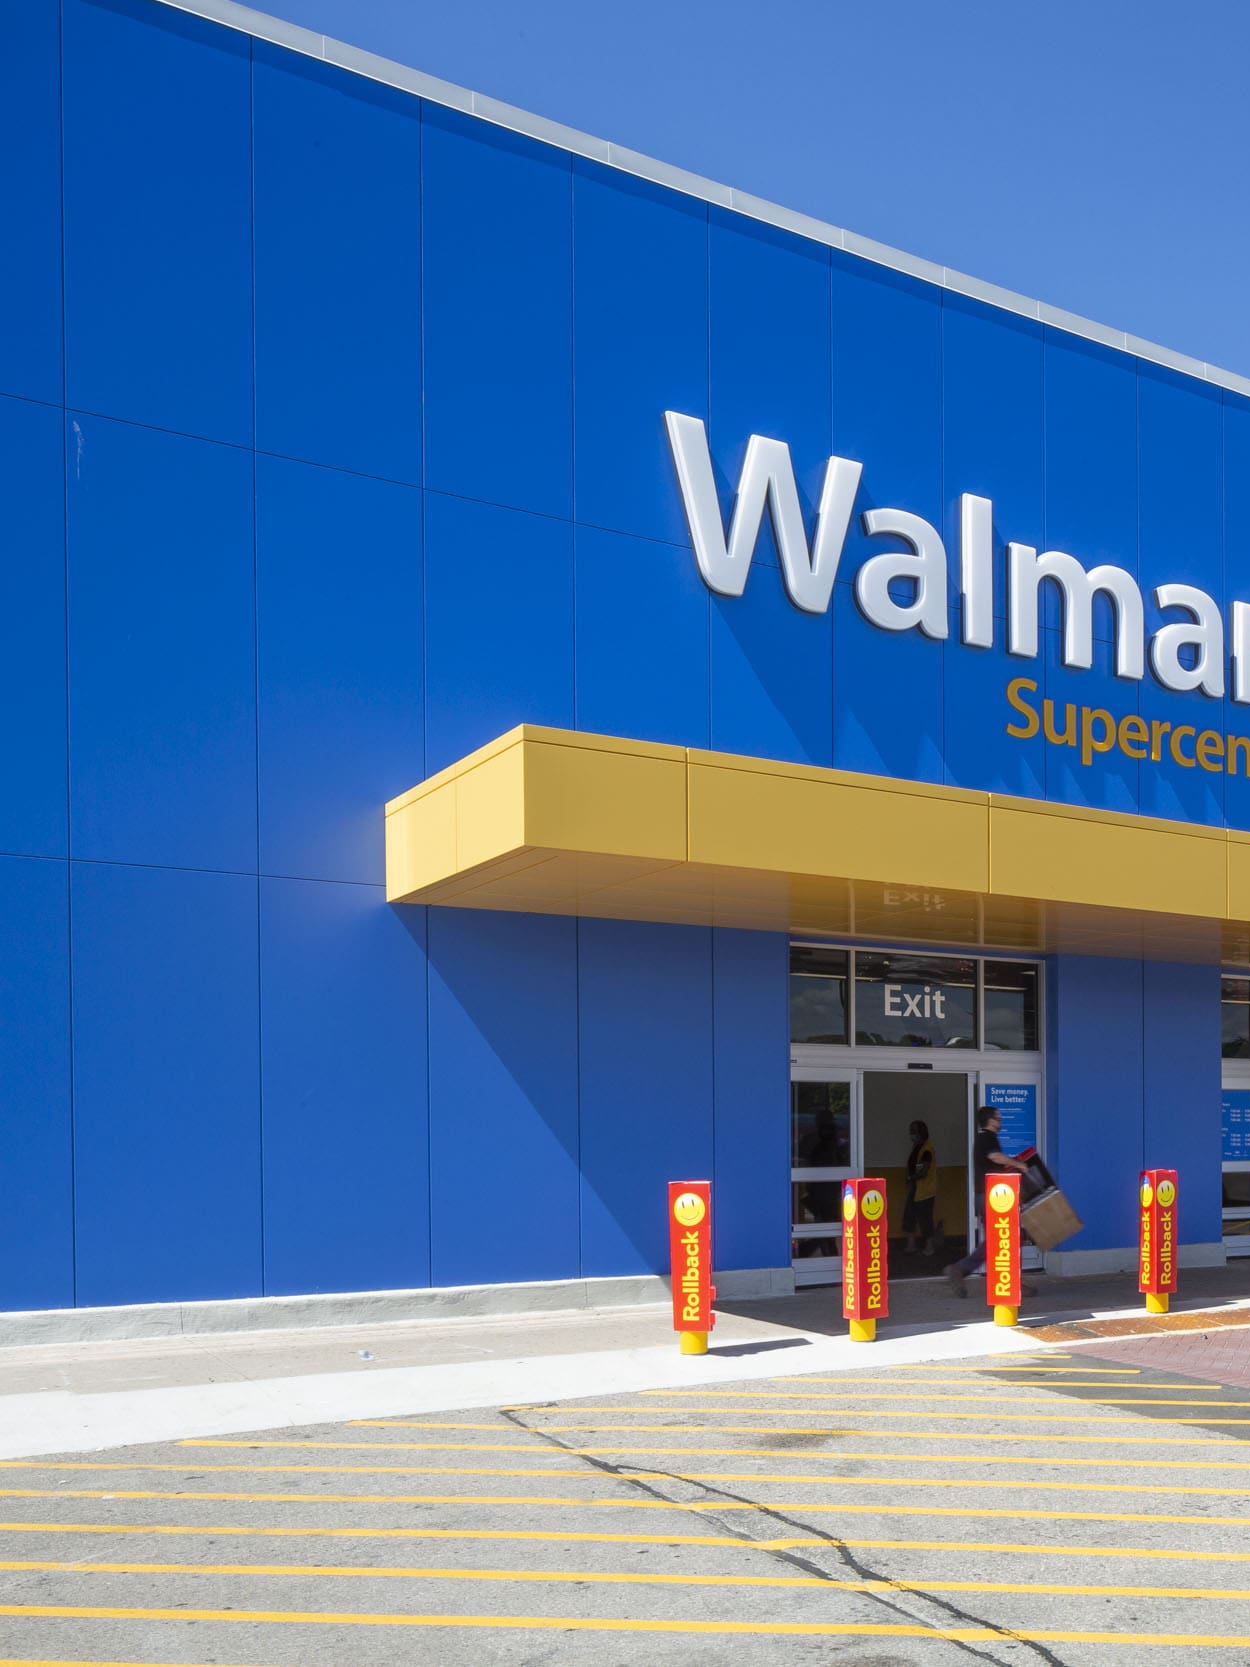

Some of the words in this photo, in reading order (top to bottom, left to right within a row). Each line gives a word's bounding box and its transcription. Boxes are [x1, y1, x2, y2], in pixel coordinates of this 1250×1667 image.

[884, 983, 945, 1019] Exit
[681, 1230, 700, 1322] Rollback
[845, 1225, 856, 1311] Rollback
[866, 1225, 881, 1309] Rollback
[995, 1216, 1011, 1297] Rollback
[1141, 1211, 1151, 1285] Rollback
[1160, 1211, 1172, 1285] Rollback
